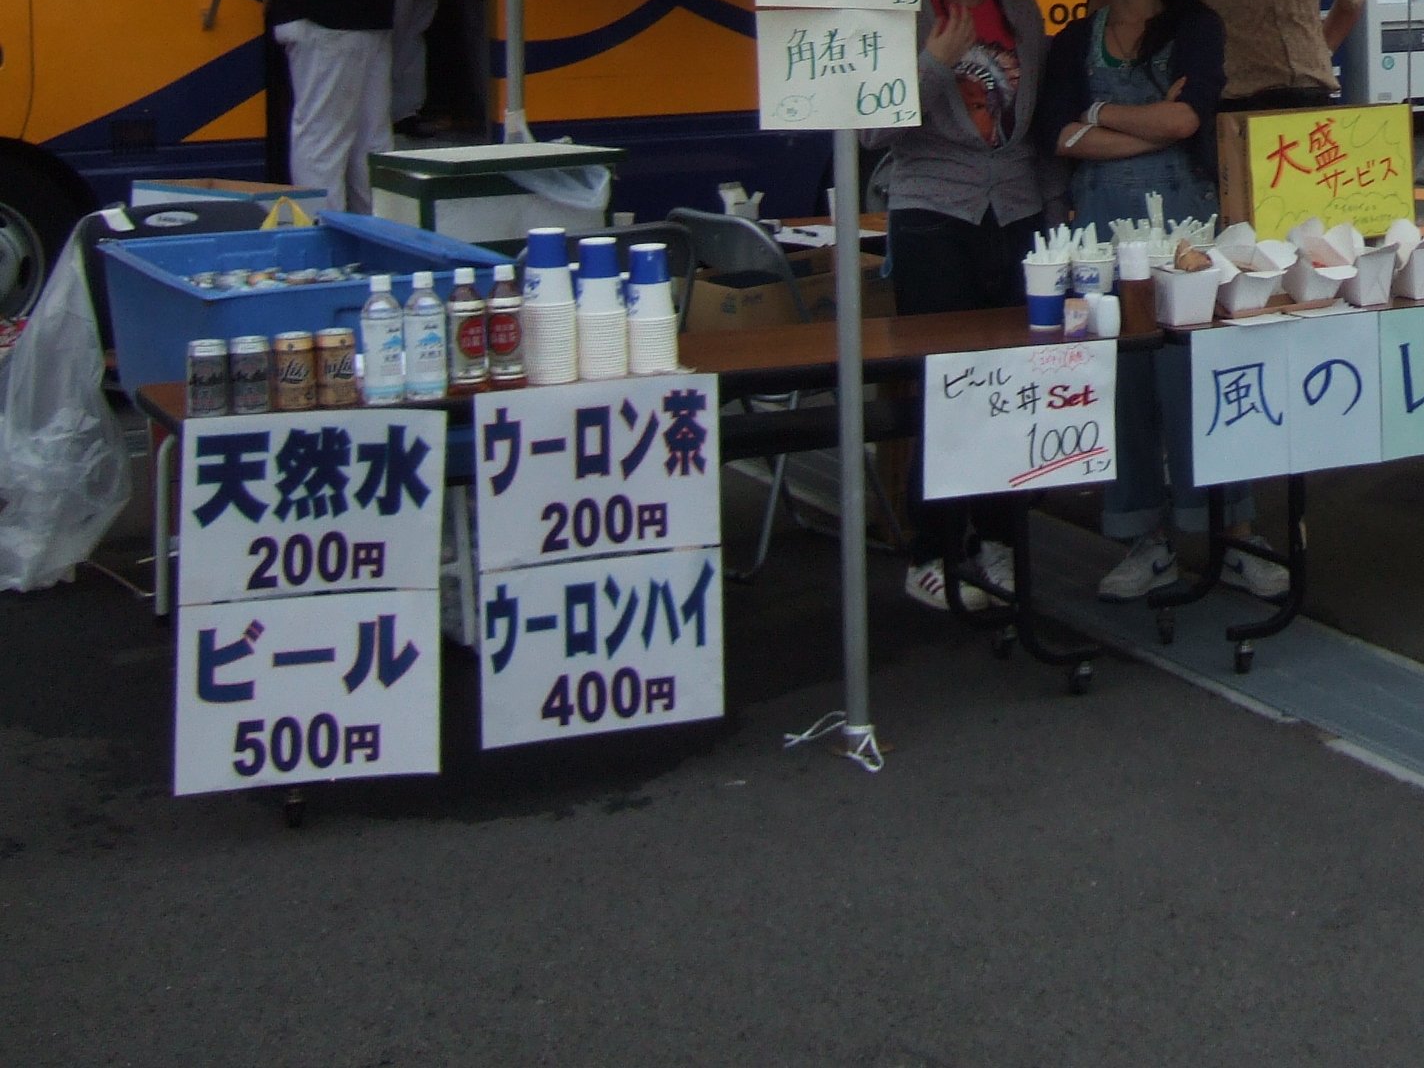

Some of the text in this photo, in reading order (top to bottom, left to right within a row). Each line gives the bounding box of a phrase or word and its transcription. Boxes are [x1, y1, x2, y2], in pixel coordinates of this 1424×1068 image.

[785, 28, 886, 82] 角煮丼
[857, 78, 906, 116] 600
[892, 110, 917, 124] エン
[1266, 118, 1348, 189] 大盛
[1316, 156, 1399, 197] サービス
[943, 367, 1013, 399] ビール
[1047, 384, 1099, 410] Set
[483, 389, 708, 497] ウーロン茶
[1082, 458, 1112, 476] エン
[192, 425, 431, 528] 天然水
[540, 495, 669, 554] 200円
[246, 532, 386, 590] 200円
[485, 559, 716, 674] ウーロンハイ
[196, 615, 420, 704] ビール
[541, 667, 676, 727] 400円
[232, 713, 381, 777] 500円
